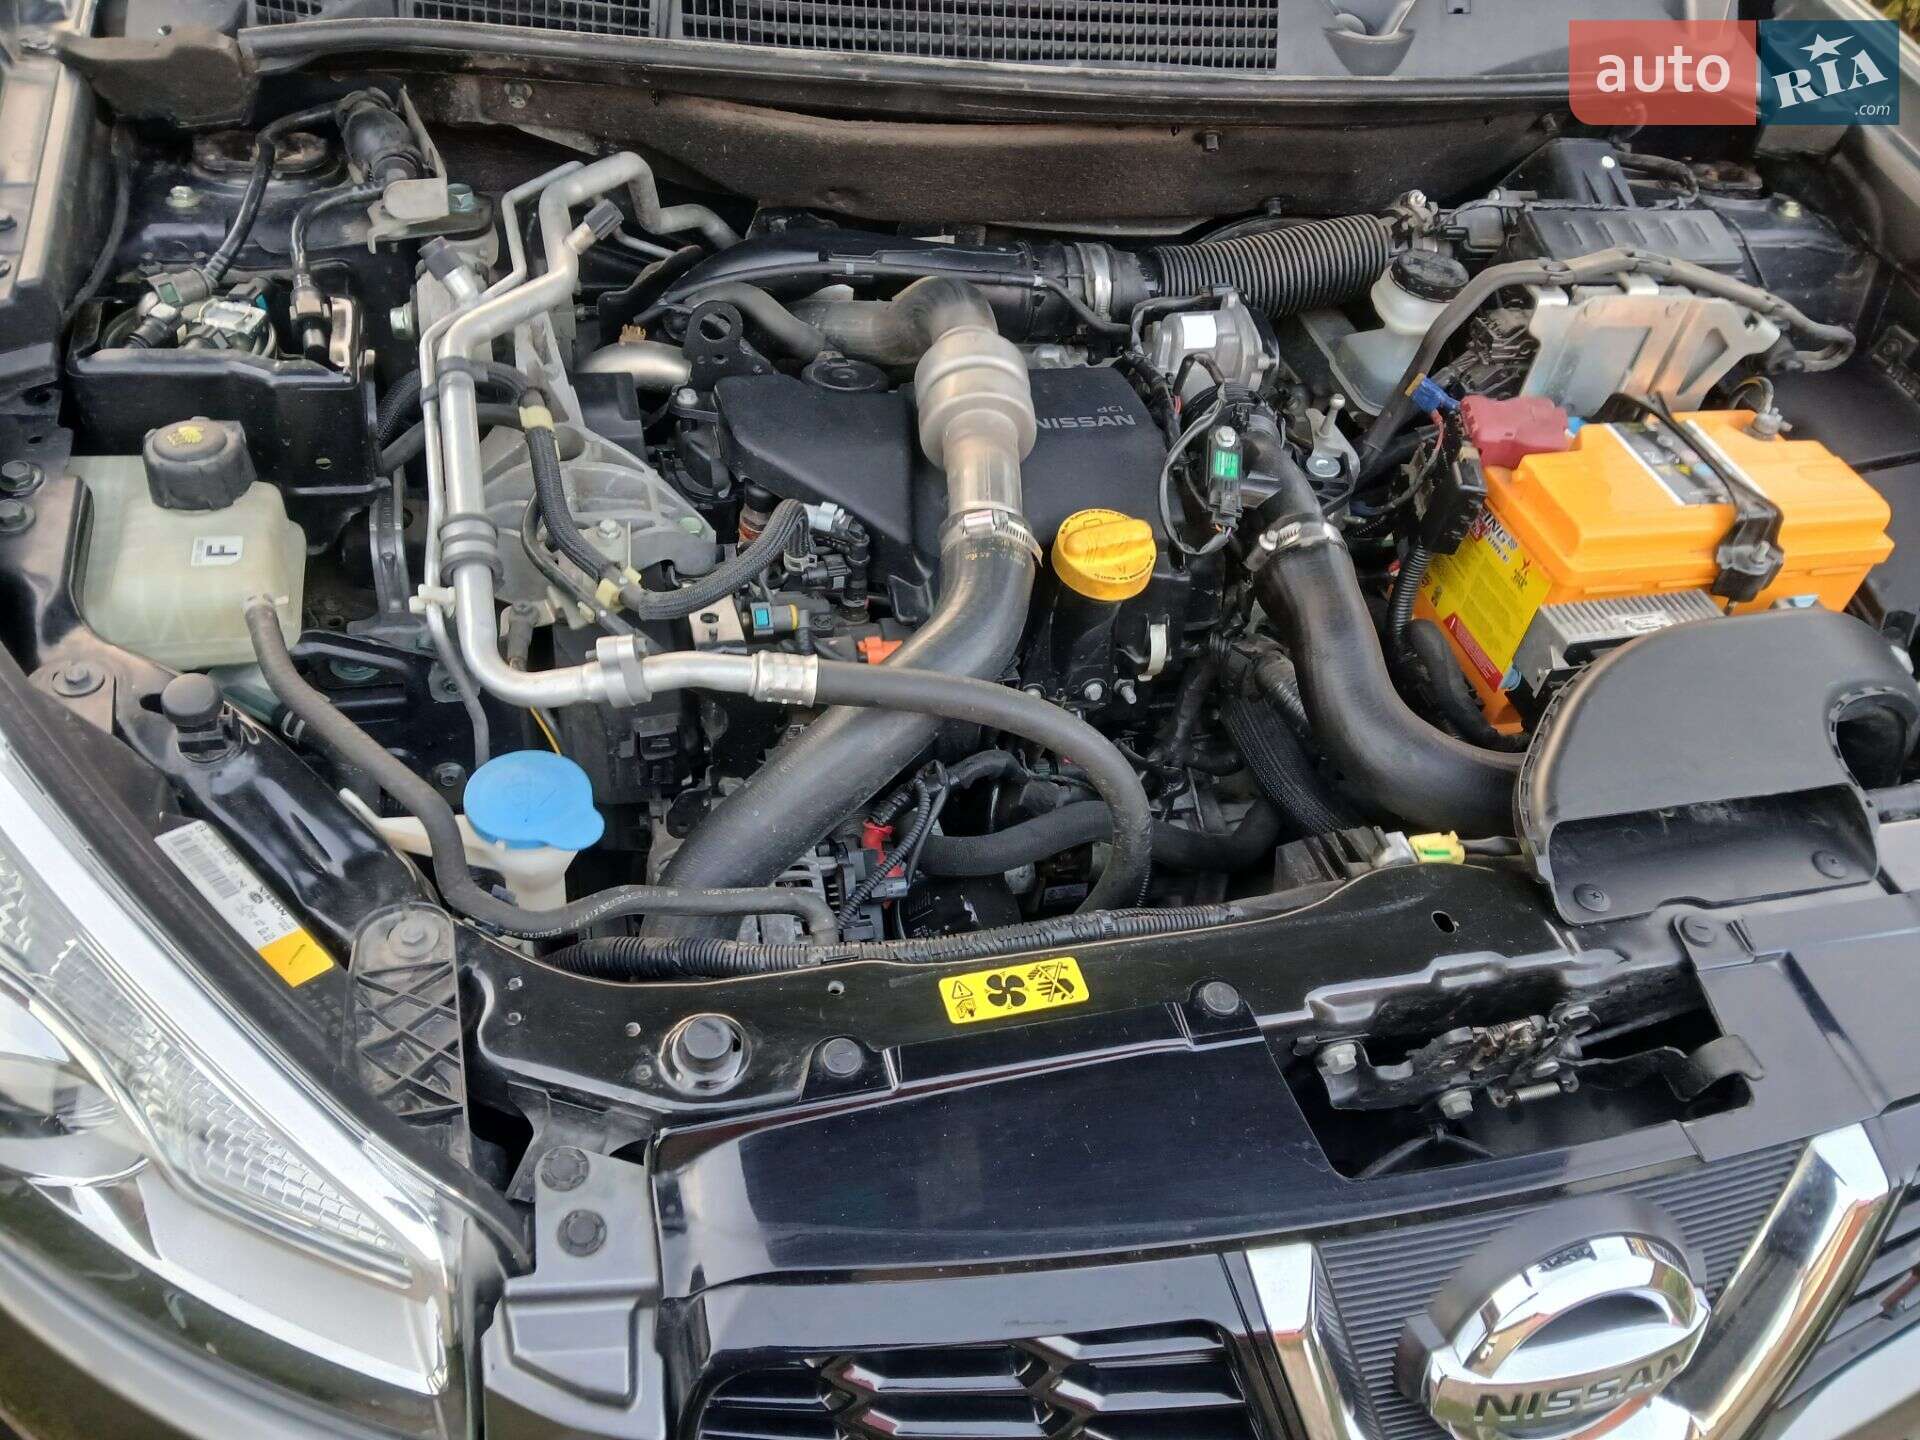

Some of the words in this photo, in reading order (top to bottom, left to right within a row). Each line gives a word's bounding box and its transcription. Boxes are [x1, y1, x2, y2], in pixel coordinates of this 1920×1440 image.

[1036, 414, 1137, 429] NISSAN
[206, 545, 238, 557] F
[1473, 1344, 1692, 1422] NISSAN
